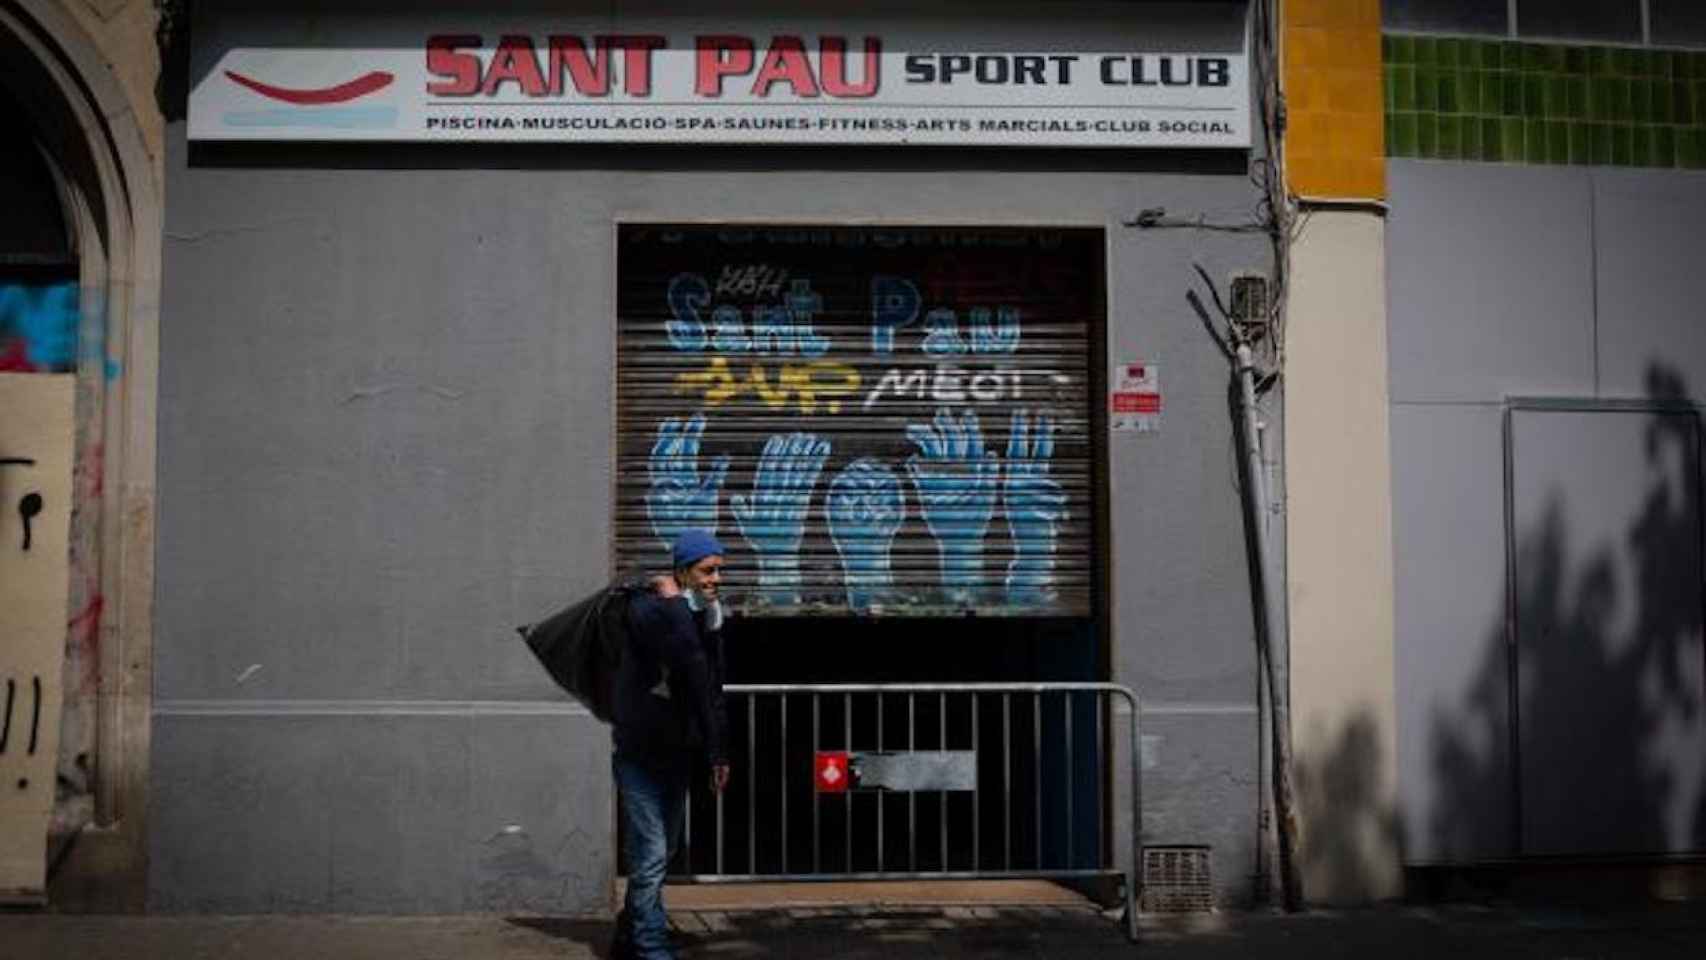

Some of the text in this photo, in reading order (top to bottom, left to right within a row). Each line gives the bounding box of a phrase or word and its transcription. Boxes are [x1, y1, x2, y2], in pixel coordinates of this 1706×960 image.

[425, 34, 1230, 98] SANT PAU SPORT CLUB
[978, 118, 1088, 133] MARCIALS
[1157, 119, 1237, 135] SOCIAL
[664, 272, 830, 356] Sant
[870, 274, 1022, 356] Pau
